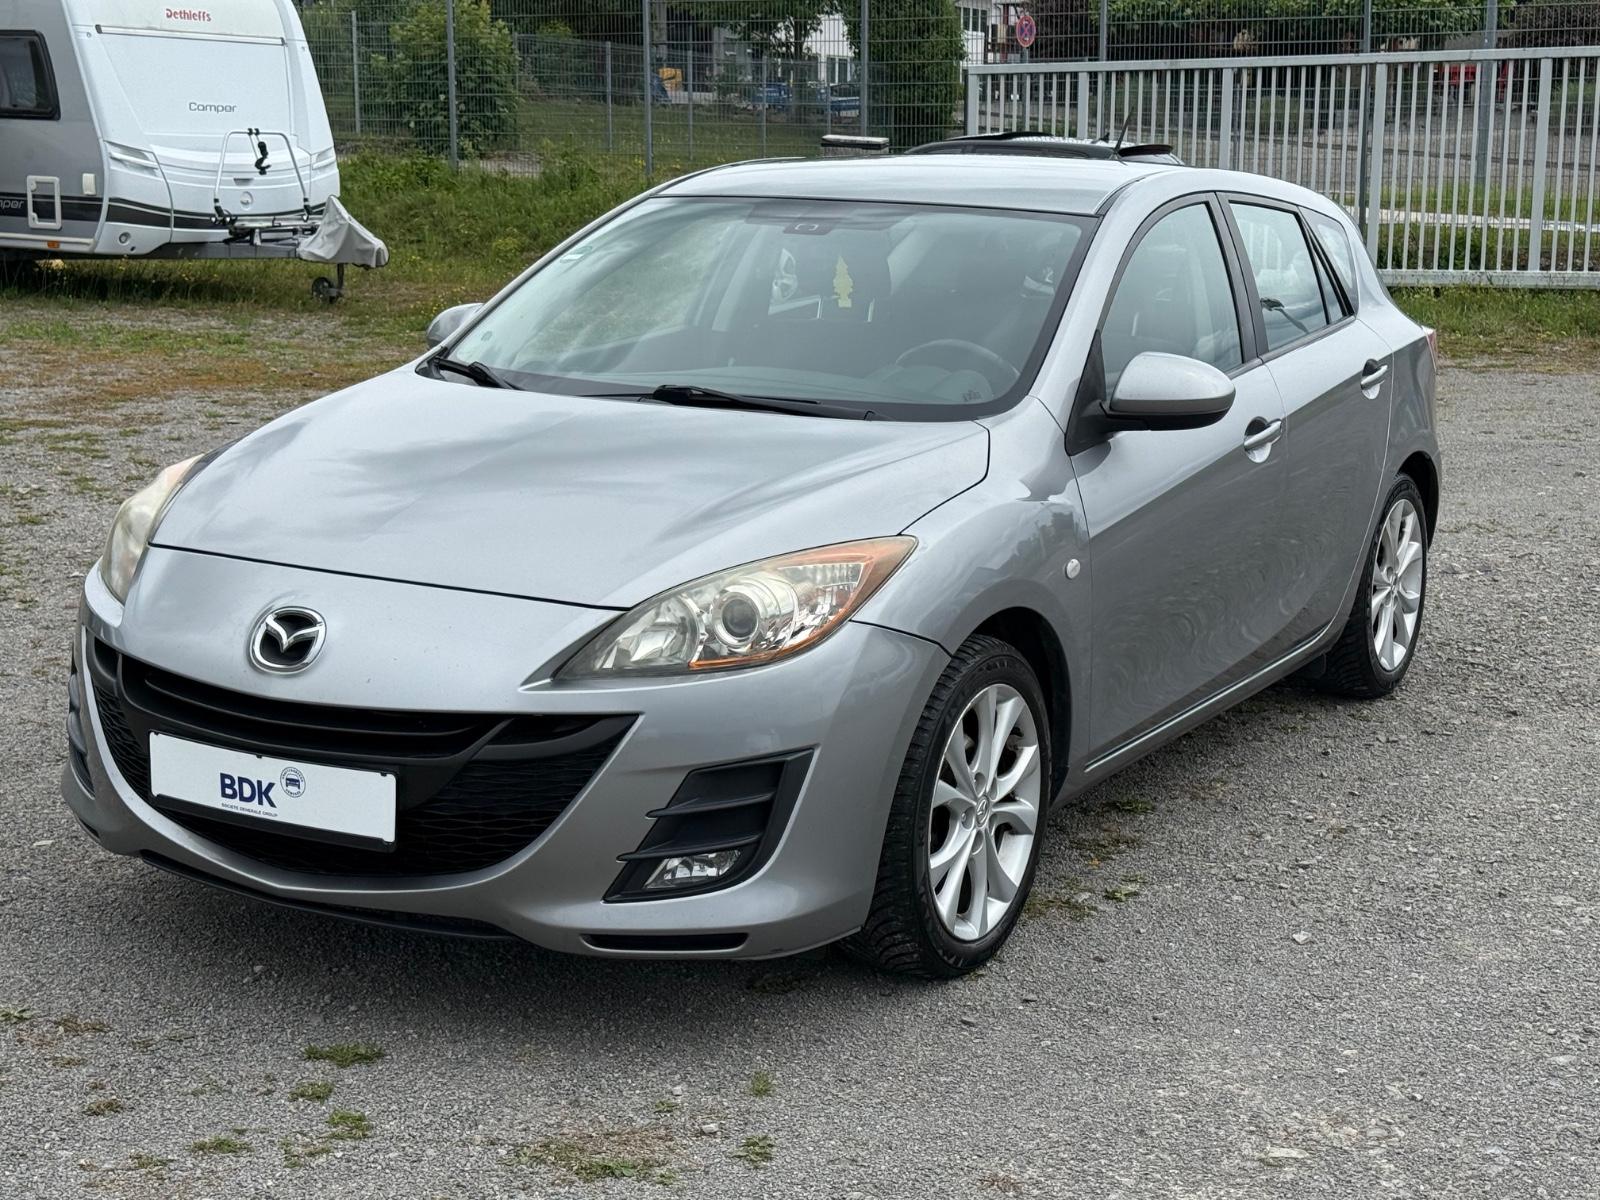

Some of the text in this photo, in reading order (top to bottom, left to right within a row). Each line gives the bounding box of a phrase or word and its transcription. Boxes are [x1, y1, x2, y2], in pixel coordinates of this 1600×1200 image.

[166, 8, 212, 21] Dethleffs
[189, 102, 237, 114] Camper
[220, 773, 277, 808] BDK
